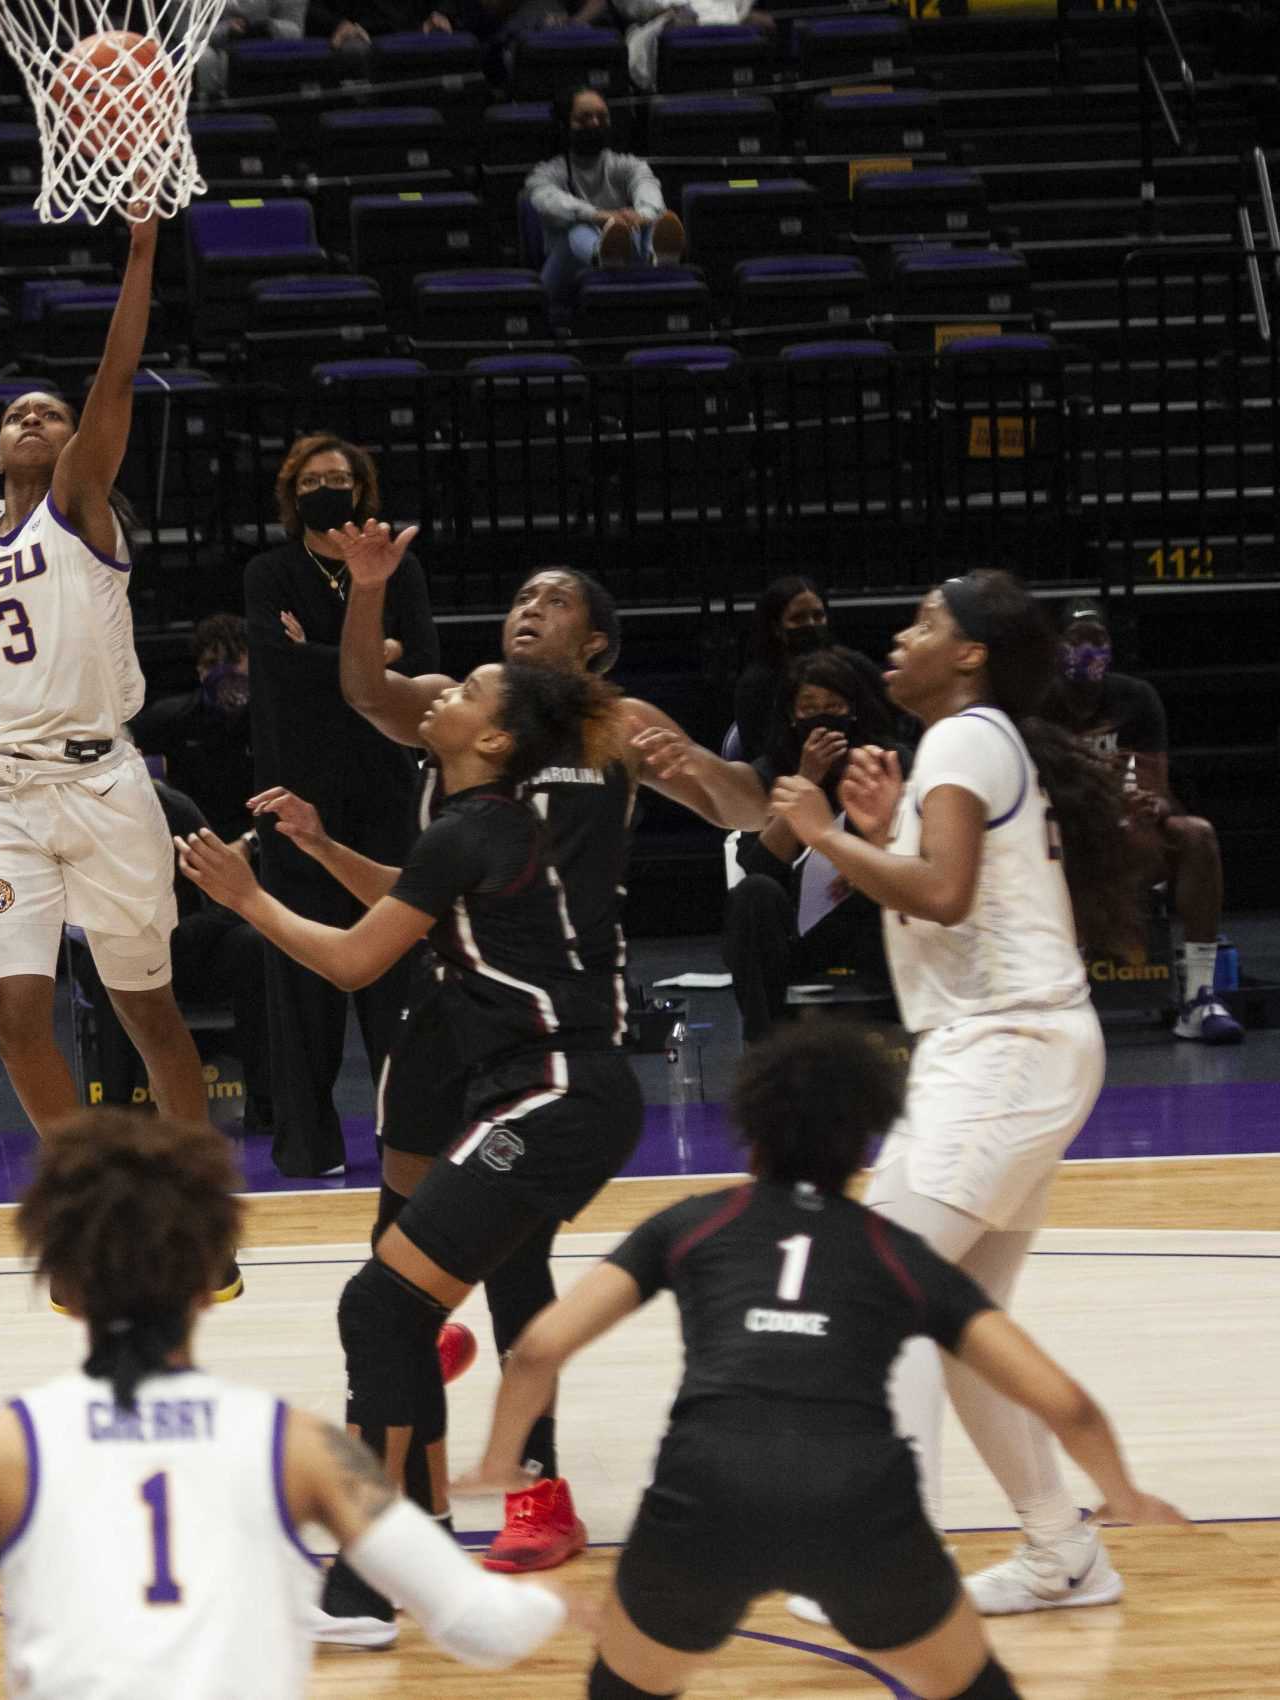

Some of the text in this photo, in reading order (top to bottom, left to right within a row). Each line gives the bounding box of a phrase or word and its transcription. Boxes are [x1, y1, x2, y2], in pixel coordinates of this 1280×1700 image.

[776, 1233, 813, 1301] 1
[744, 1306, 830, 1336] COOKE
[139, 1467, 184, 1606] 1
